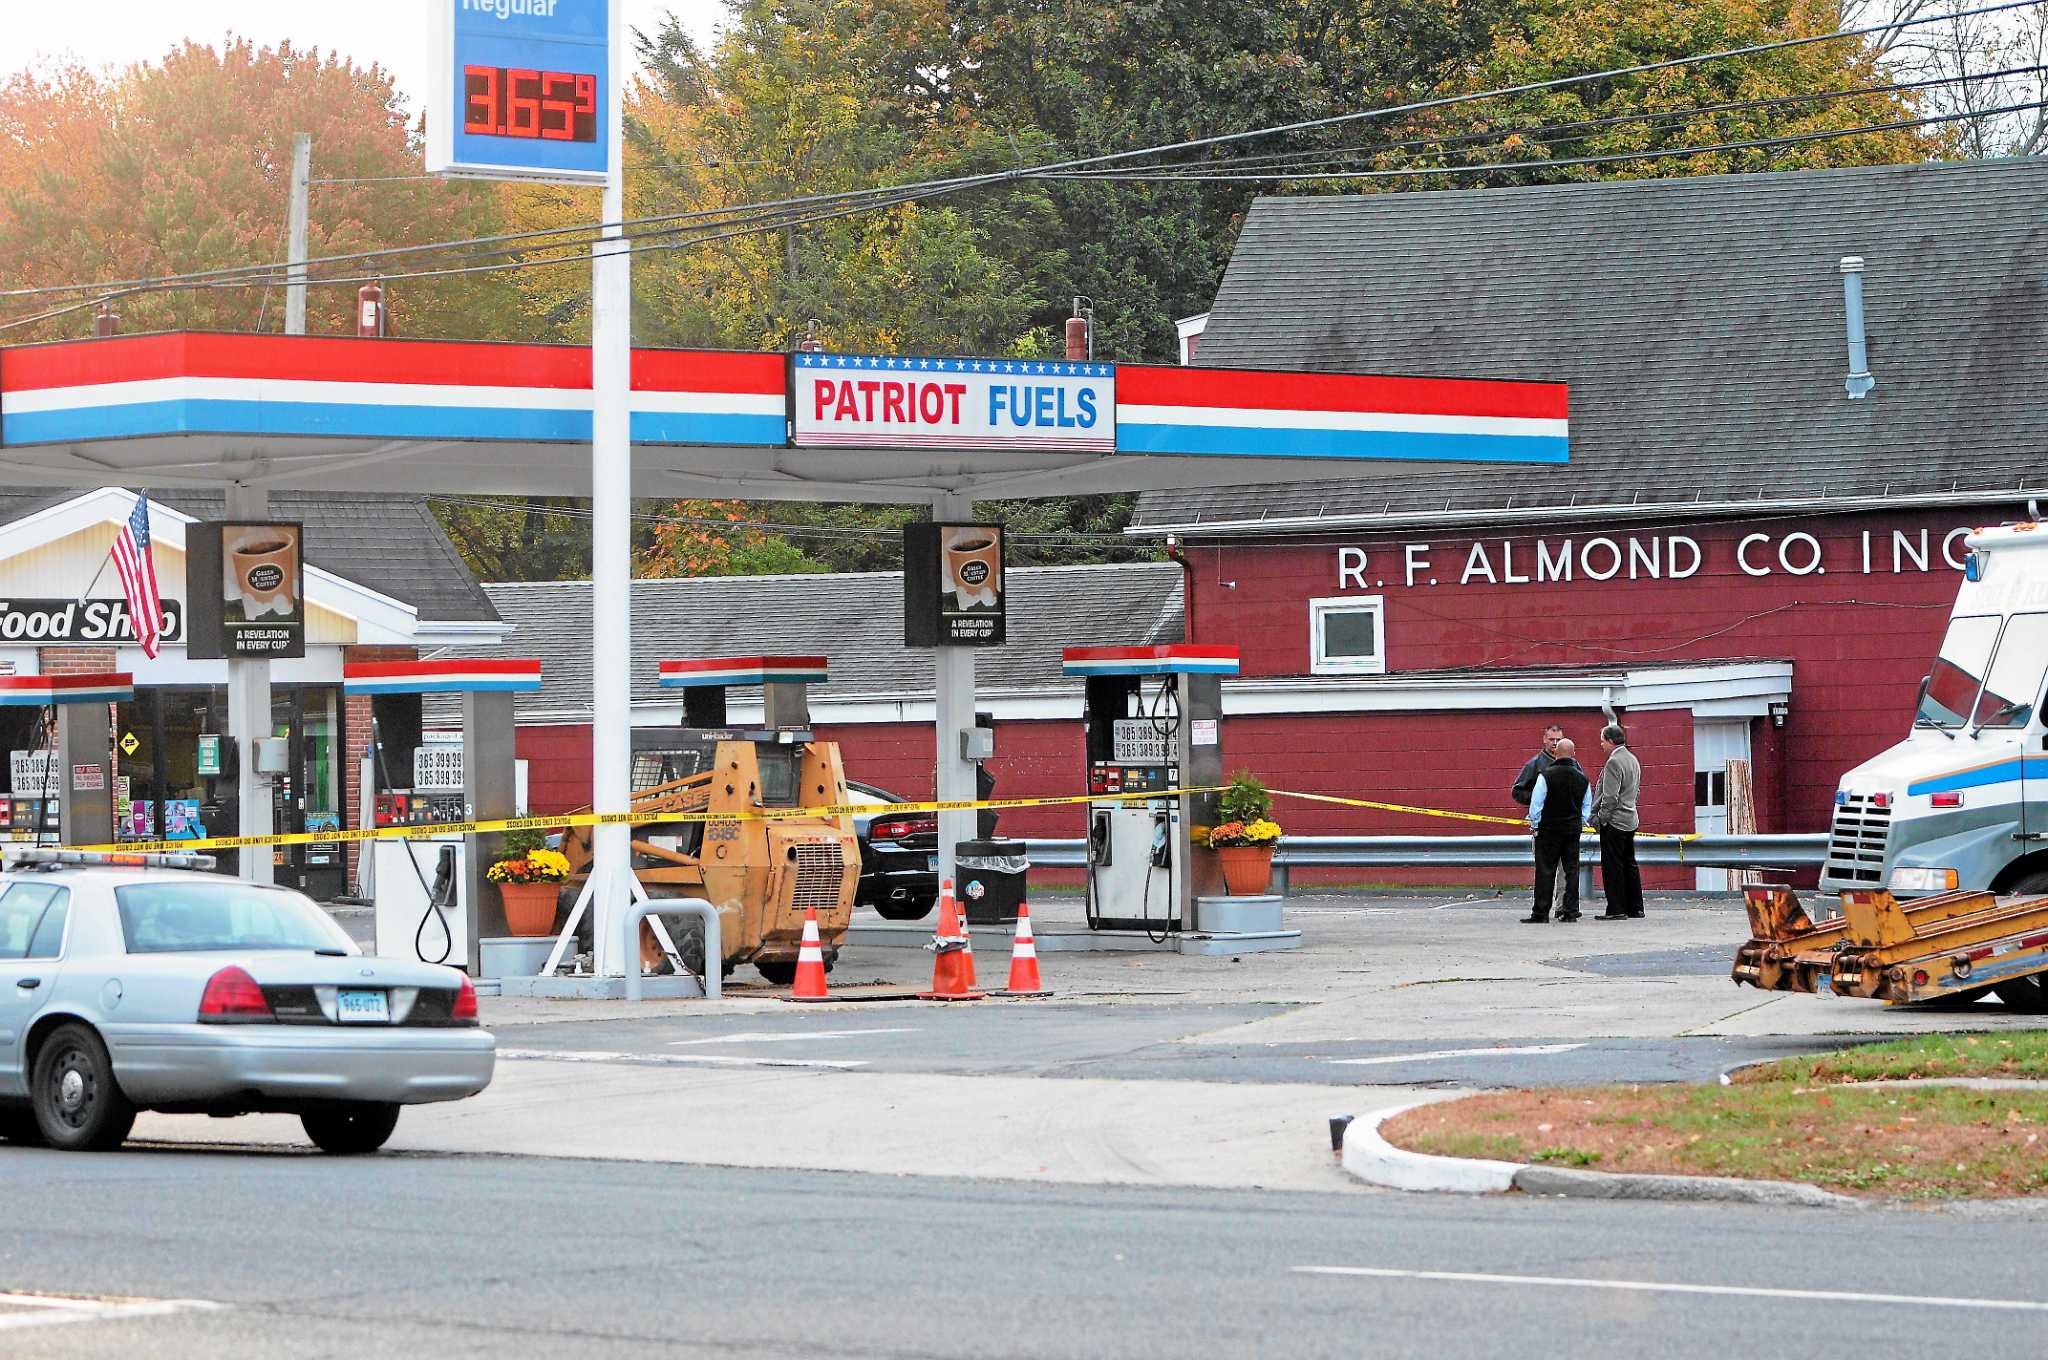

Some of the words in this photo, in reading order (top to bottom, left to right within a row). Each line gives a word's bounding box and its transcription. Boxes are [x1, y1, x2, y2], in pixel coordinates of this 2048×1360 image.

[814, 379, 966, 424] PATRIOT
[989, 384, 1097, 429] FUELS
[1338, 547, 1384, 588] R.
[1405, 545, 1437, 586] F.
[1460, 535, 1702, 585] ALMOND
[1737, 532, 1825, 576] CO.
[952, 620, 957, 628] A
[957, 620, 994, 628] REVELATION
[237, 631, 243, 639] A
[244, 630, 290, 639] REVELATION
[951, 629, 959, 637] IN
[960, 629, 978, 637] EVERY
[236, 641, 245, 650] IN
[247, 641, 270, 650] EVERY
[418, 753, 433, 768] 365
[418, 770, 433, 785] 365
[436, 770, 450, 785] 399
[465, 803, 473, 815] 3
[458, 824, 476, 832] POLICE
[330, 832, 340, 840] NOT
[362, 830, 379, 838] POLICE
[252, 837, 263, 845] LINE
[264, 836, 282, 844] POLICE
